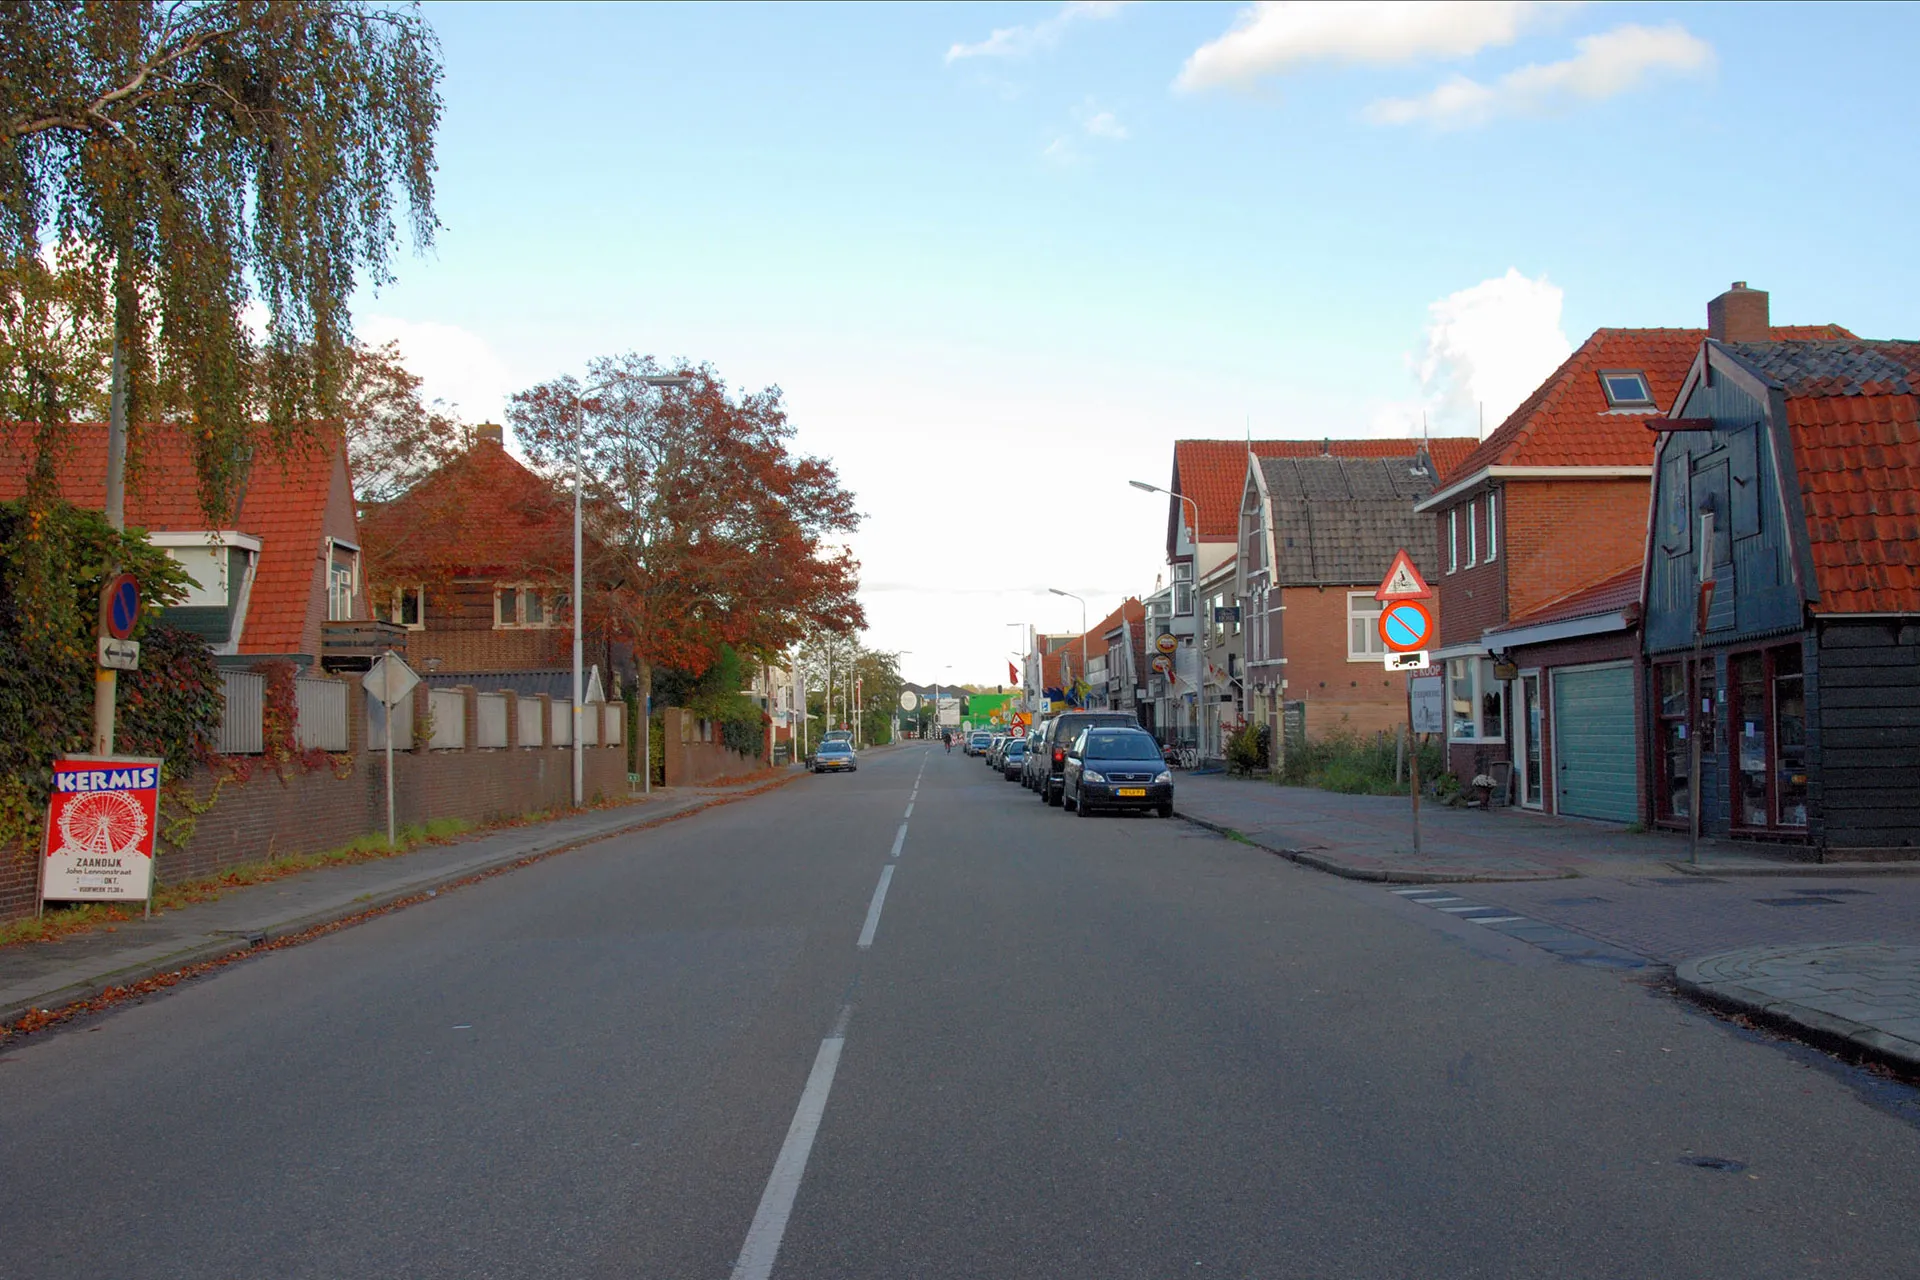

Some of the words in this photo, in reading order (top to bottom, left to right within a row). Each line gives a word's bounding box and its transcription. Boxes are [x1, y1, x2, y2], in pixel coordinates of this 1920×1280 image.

[1420, 665, 1440, 676] KOOP
[57, 768, 155, 792] KERMIS
[76, 858, 122, 867] ZAANDIJK
